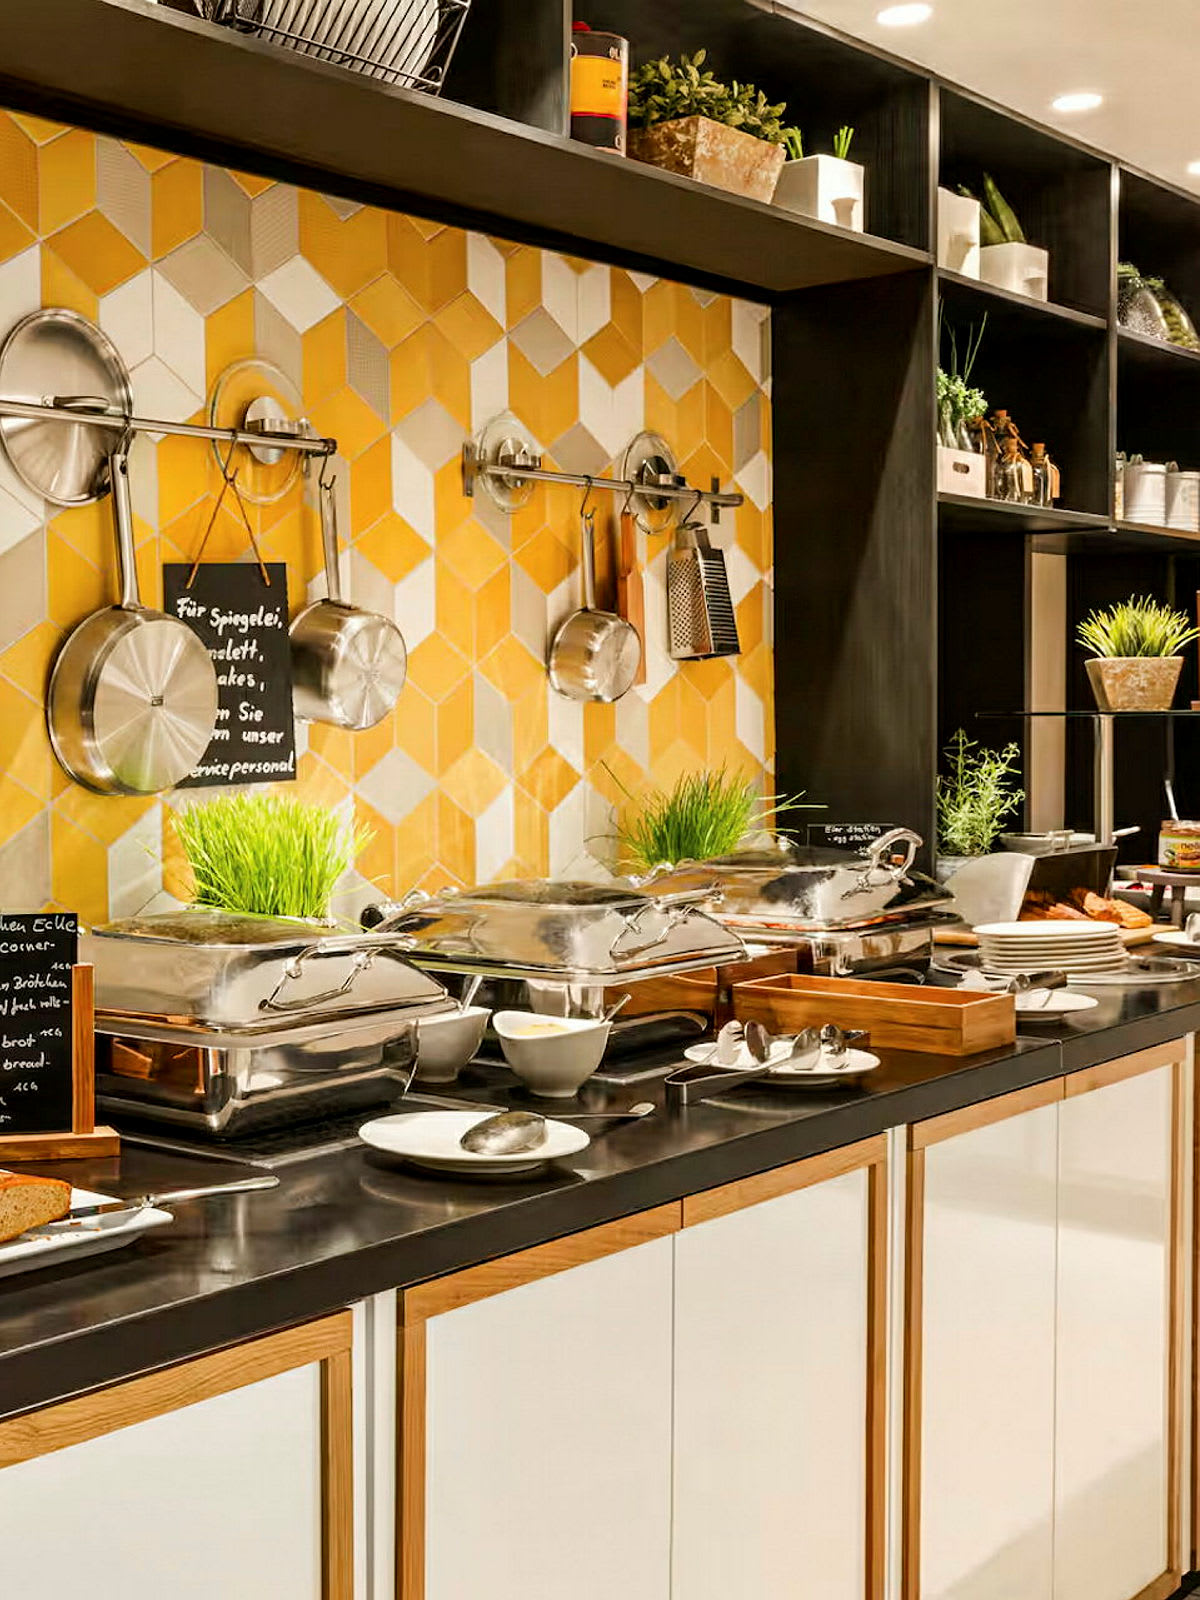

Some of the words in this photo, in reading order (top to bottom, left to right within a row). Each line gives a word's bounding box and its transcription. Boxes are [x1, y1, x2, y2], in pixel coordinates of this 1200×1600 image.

[177, 597, 206, 618] Für
[210, 605, 283, 636] Spiegelei,
[239, 701, 264, 722] Sie
[242, 731, 284, 744] unser
[190, 750, 295, 780] ervicepersonal
[32, 915, 77, 933] Ecke
[13, 973, 67, 989] Brötchen
[1, 1033, 37, 1049] brot
